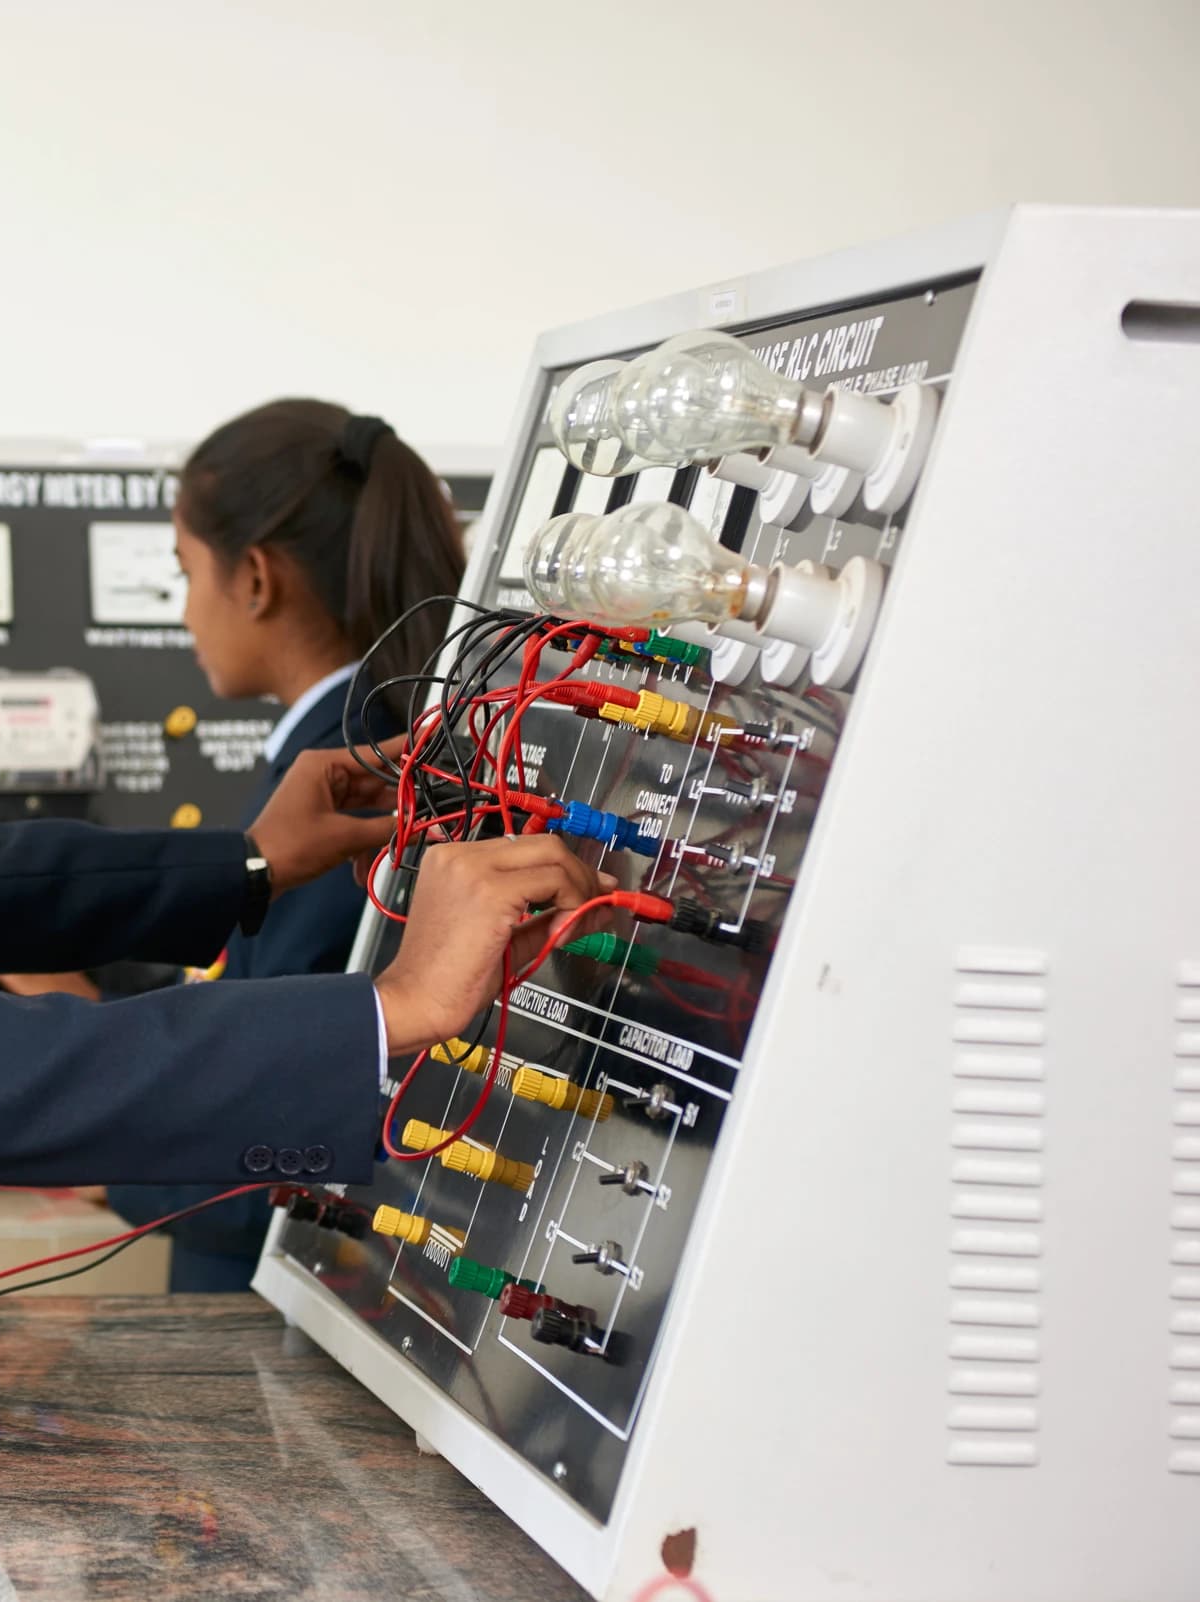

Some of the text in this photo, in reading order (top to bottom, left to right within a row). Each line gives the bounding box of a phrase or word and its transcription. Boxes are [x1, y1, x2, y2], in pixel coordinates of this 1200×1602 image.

[750, 341, 790, 373] ASE
[785, 333, 819, 381] RLC
[815, 316, 884, 377] CIRCUIT
[864, 366, 900, 392] PHASE
[898, 360, 929, 385] LOAD
[43, 473, 125, 507] METER
[127, 474, 160, 508] BY
[657, 664, 664, 681] L
[671, 664, 680, 682] C
[684, 666, 694, 684] V
[706, 722, 721, 742] L1
[799, 727, 816, 751] S1
[514, 742, 547, 766] OLTAGE
[660, 764, 673, 784] TO
[688, 779, 704, 800] L2
[780, 790, 797, 813] S2
[636, 790, 680, 816] CONNECT
[637, 817, 663, 839] LOAD
[509, 986, 569, 1023] INDUCTIVE LOAD
[619, 1025, 694, 1071] CAPACITOR LOAD
[596, 1071, 609, 1092] C1
[682, 1102, 700, 1128] S1
[572, 1141, 585, 1162] C2
[656, 1184, 672, 1210] S2
